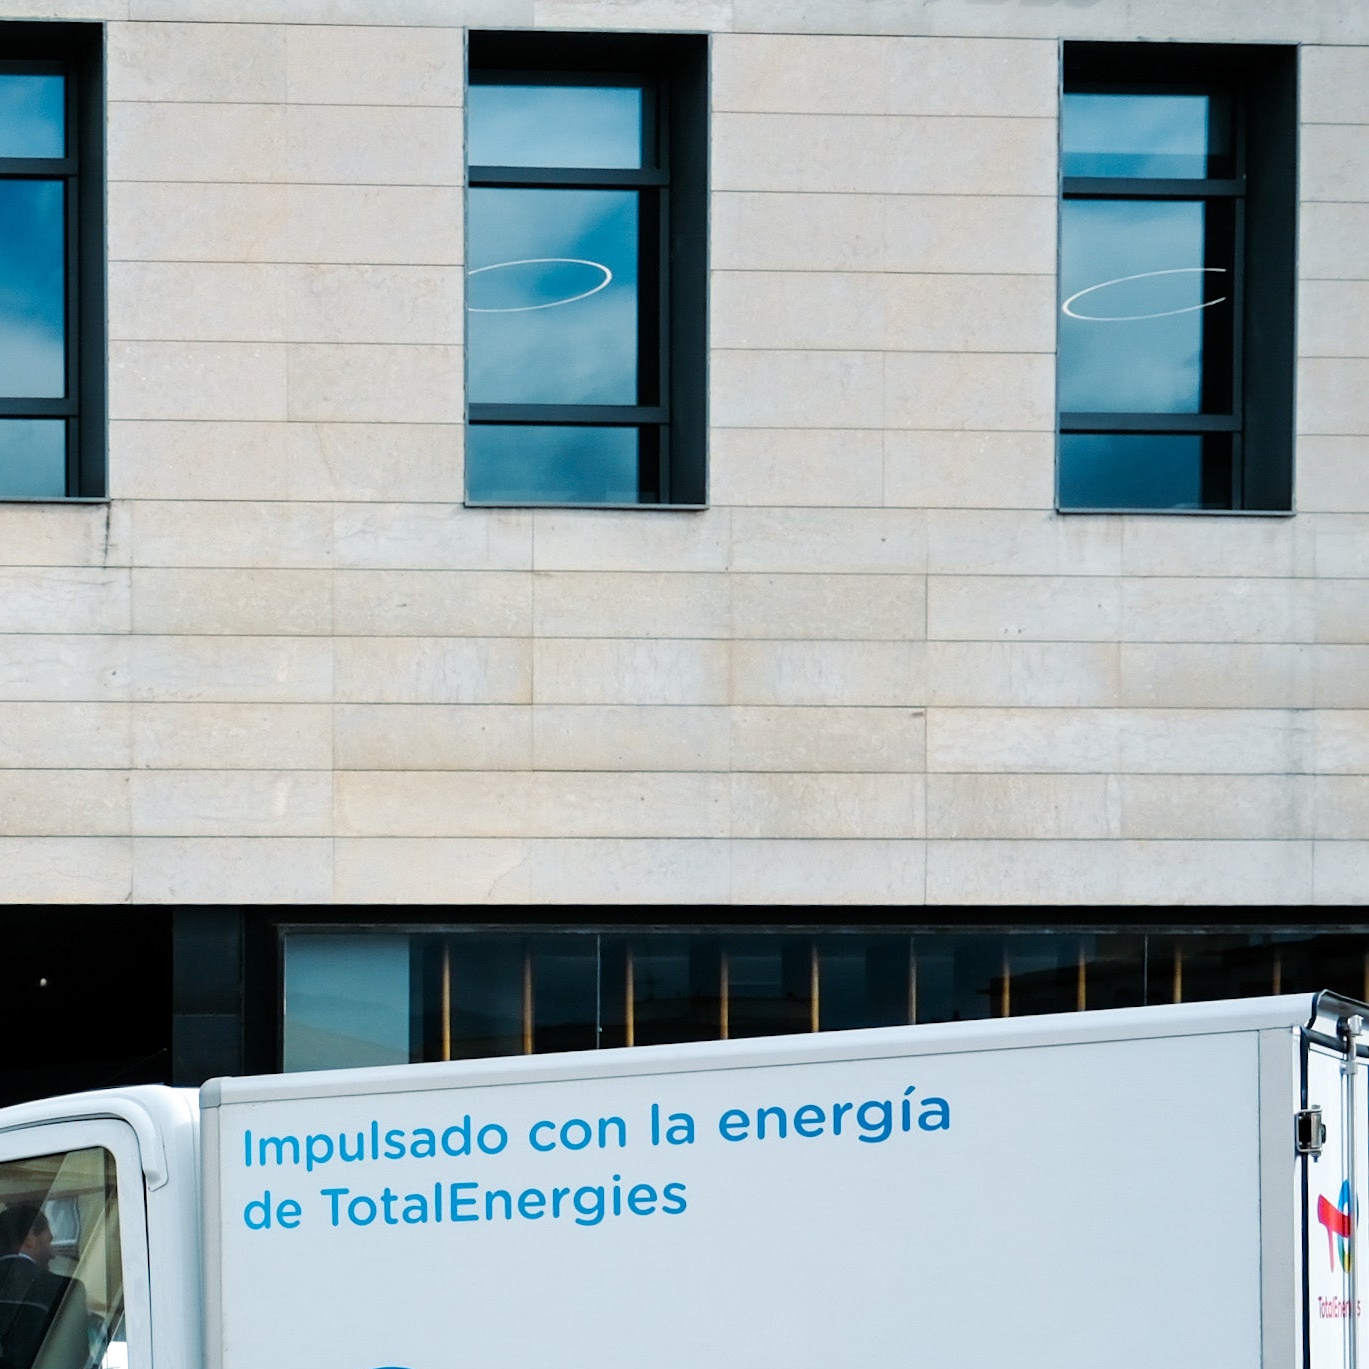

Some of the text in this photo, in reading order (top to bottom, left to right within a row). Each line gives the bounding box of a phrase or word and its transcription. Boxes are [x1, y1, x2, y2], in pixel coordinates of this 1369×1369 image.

[244, 1085, 952, 1172] Impulsado con la energía
[243, 1174, 689, 1230] de TotalEnergies
